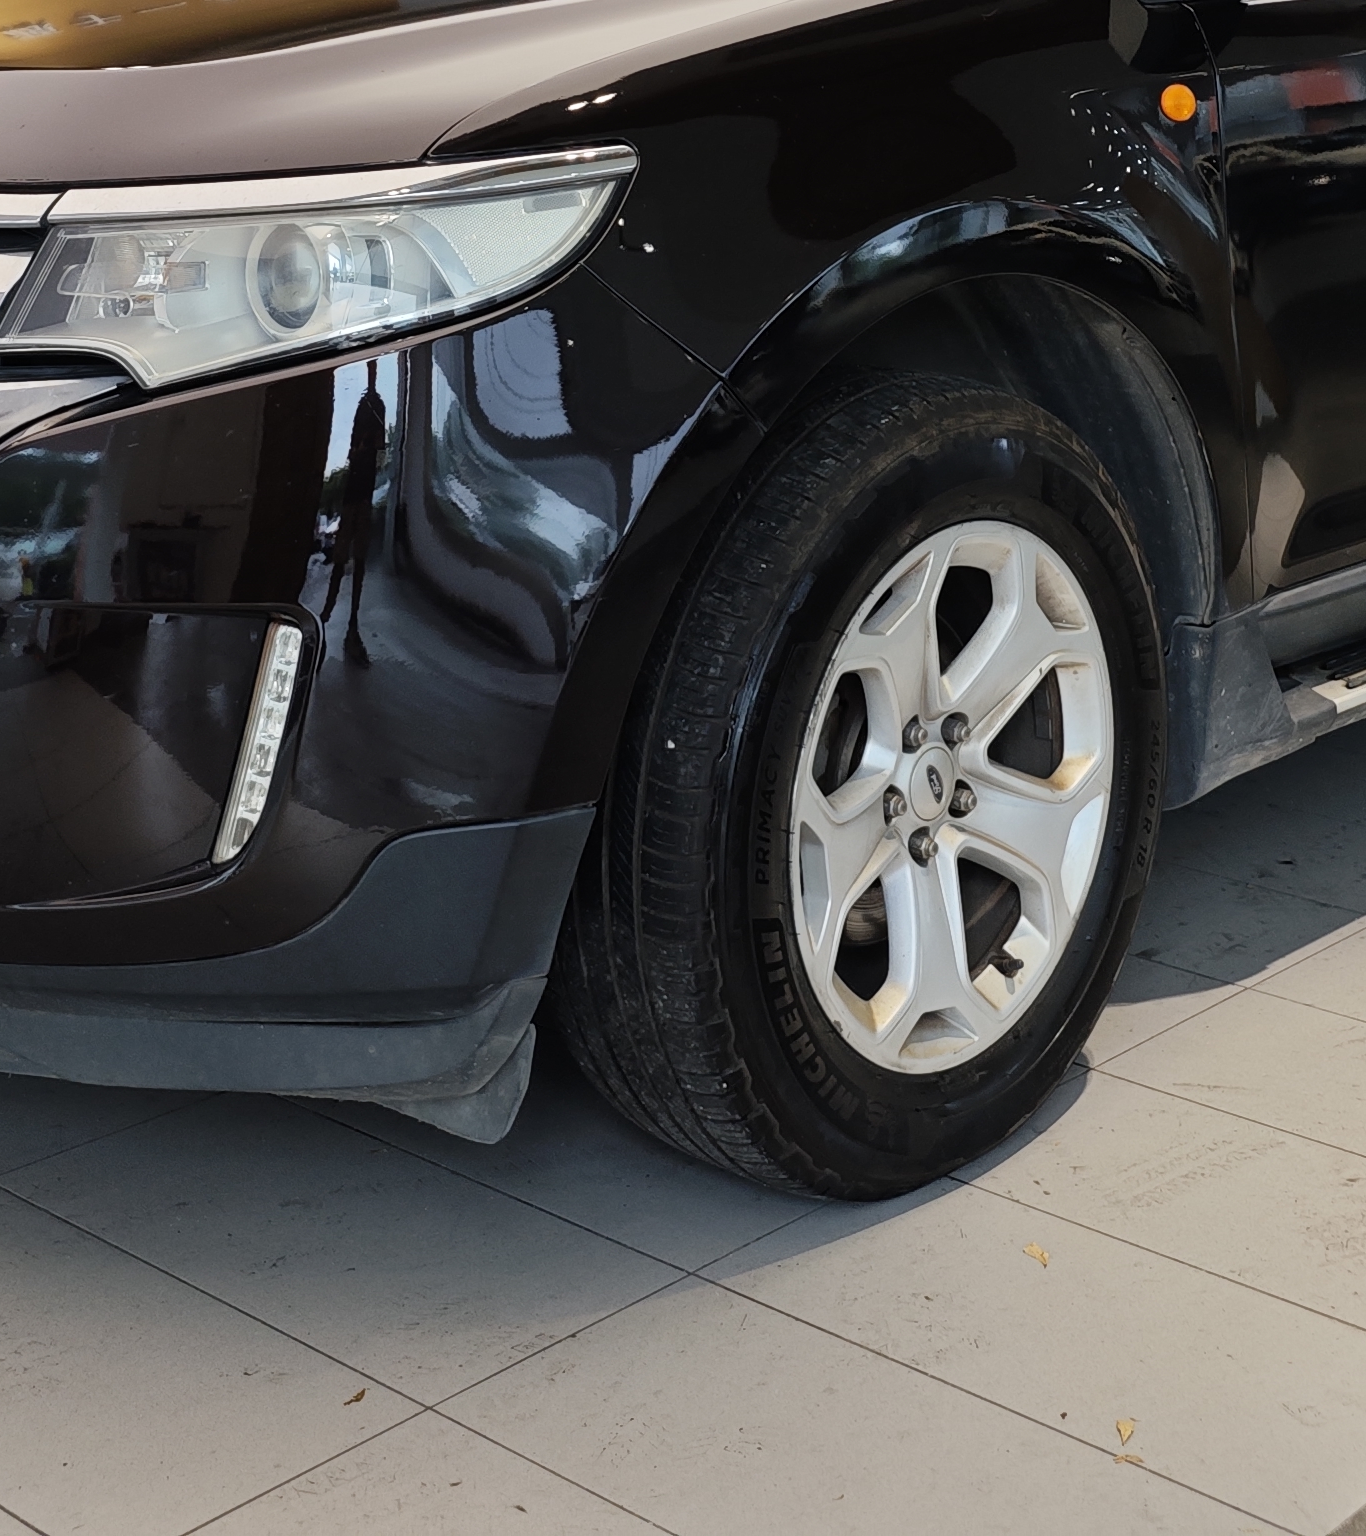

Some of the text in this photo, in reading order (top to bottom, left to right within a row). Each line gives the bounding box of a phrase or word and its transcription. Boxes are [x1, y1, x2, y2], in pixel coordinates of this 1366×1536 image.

[755, 744, 782, 885] PRIMACY
[1136, 720, 1161, 868] 245/60 R 18
[761, 930, 860, 1121] MICHELIN
